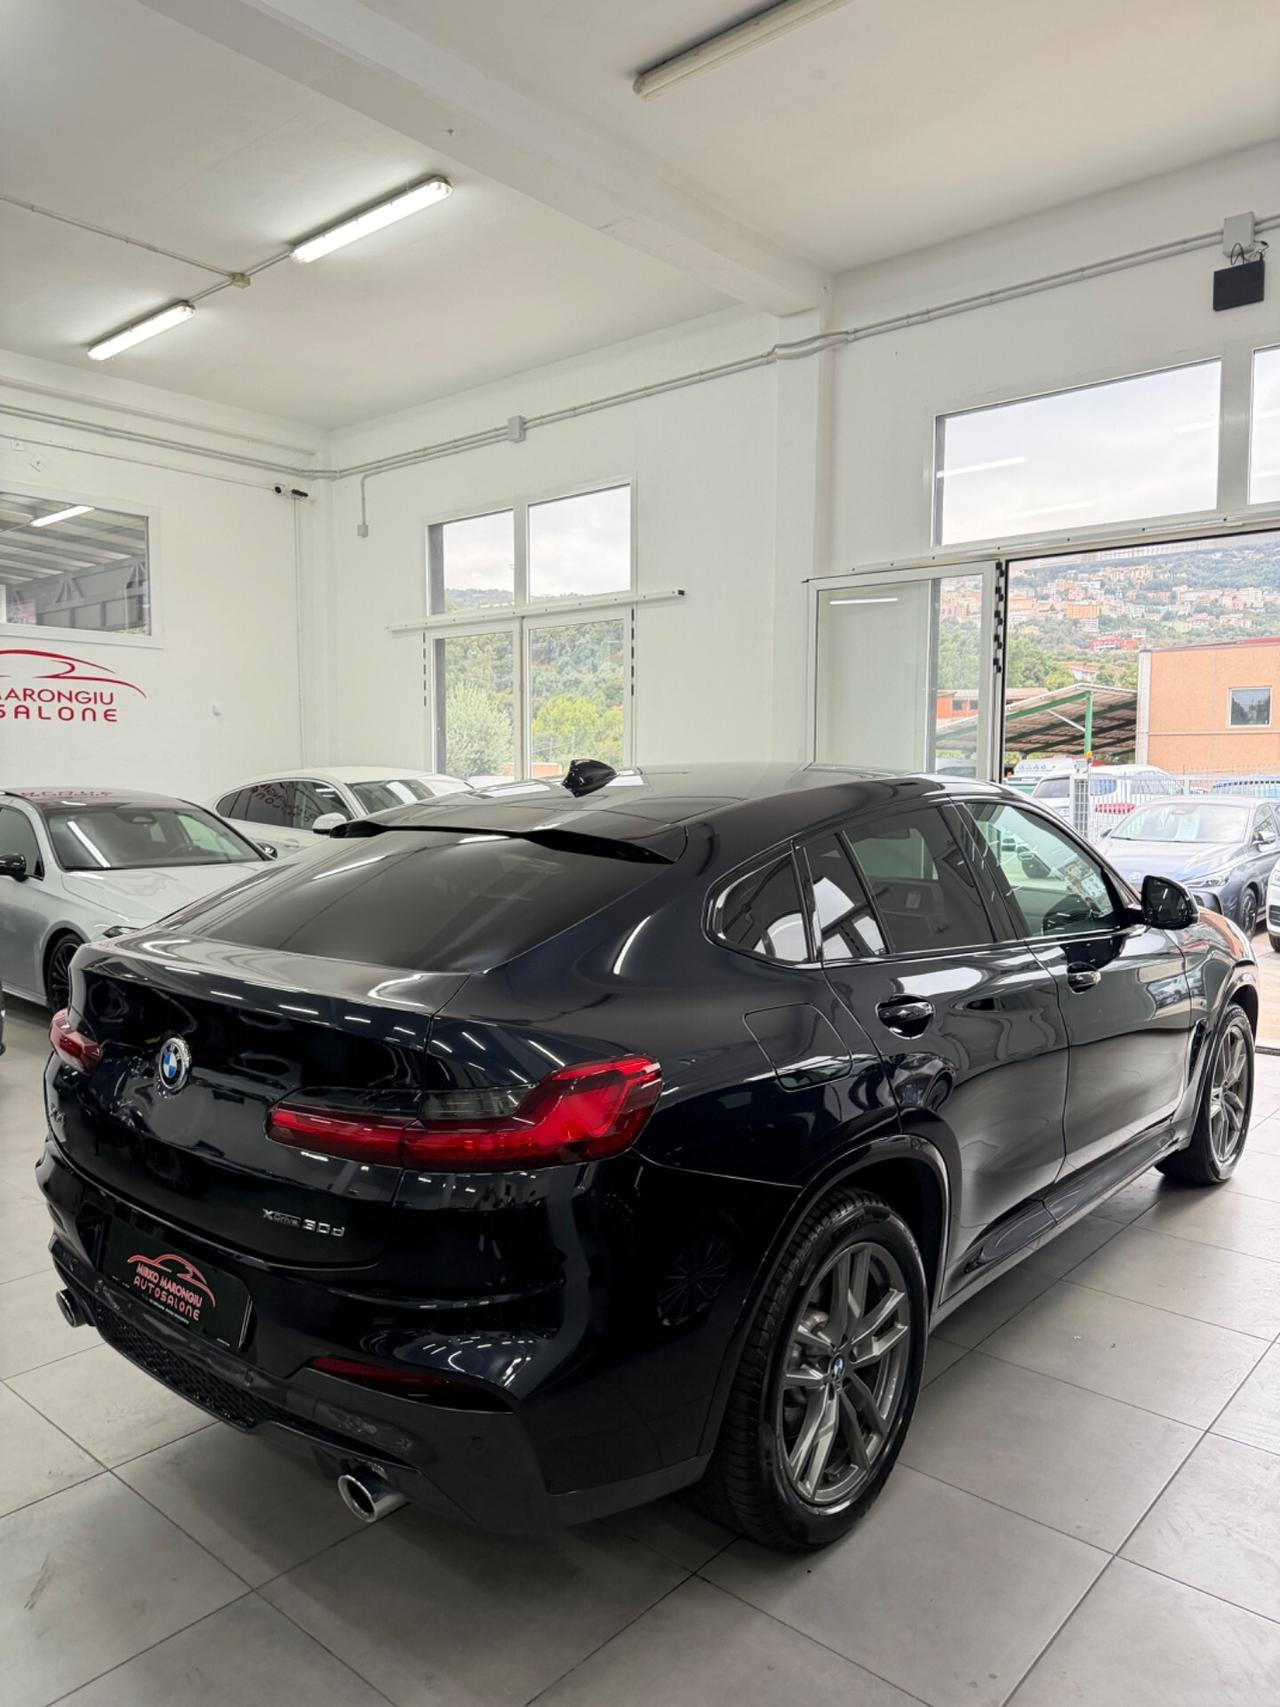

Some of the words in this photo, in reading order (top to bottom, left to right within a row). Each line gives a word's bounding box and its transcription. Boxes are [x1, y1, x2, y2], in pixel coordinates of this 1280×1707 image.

[0, 688, 114, 705] ARONGIU
[133, 1276, 200, 1321] AUTOSALONE
[160, 1277, 203, 1308] MARONGIU
